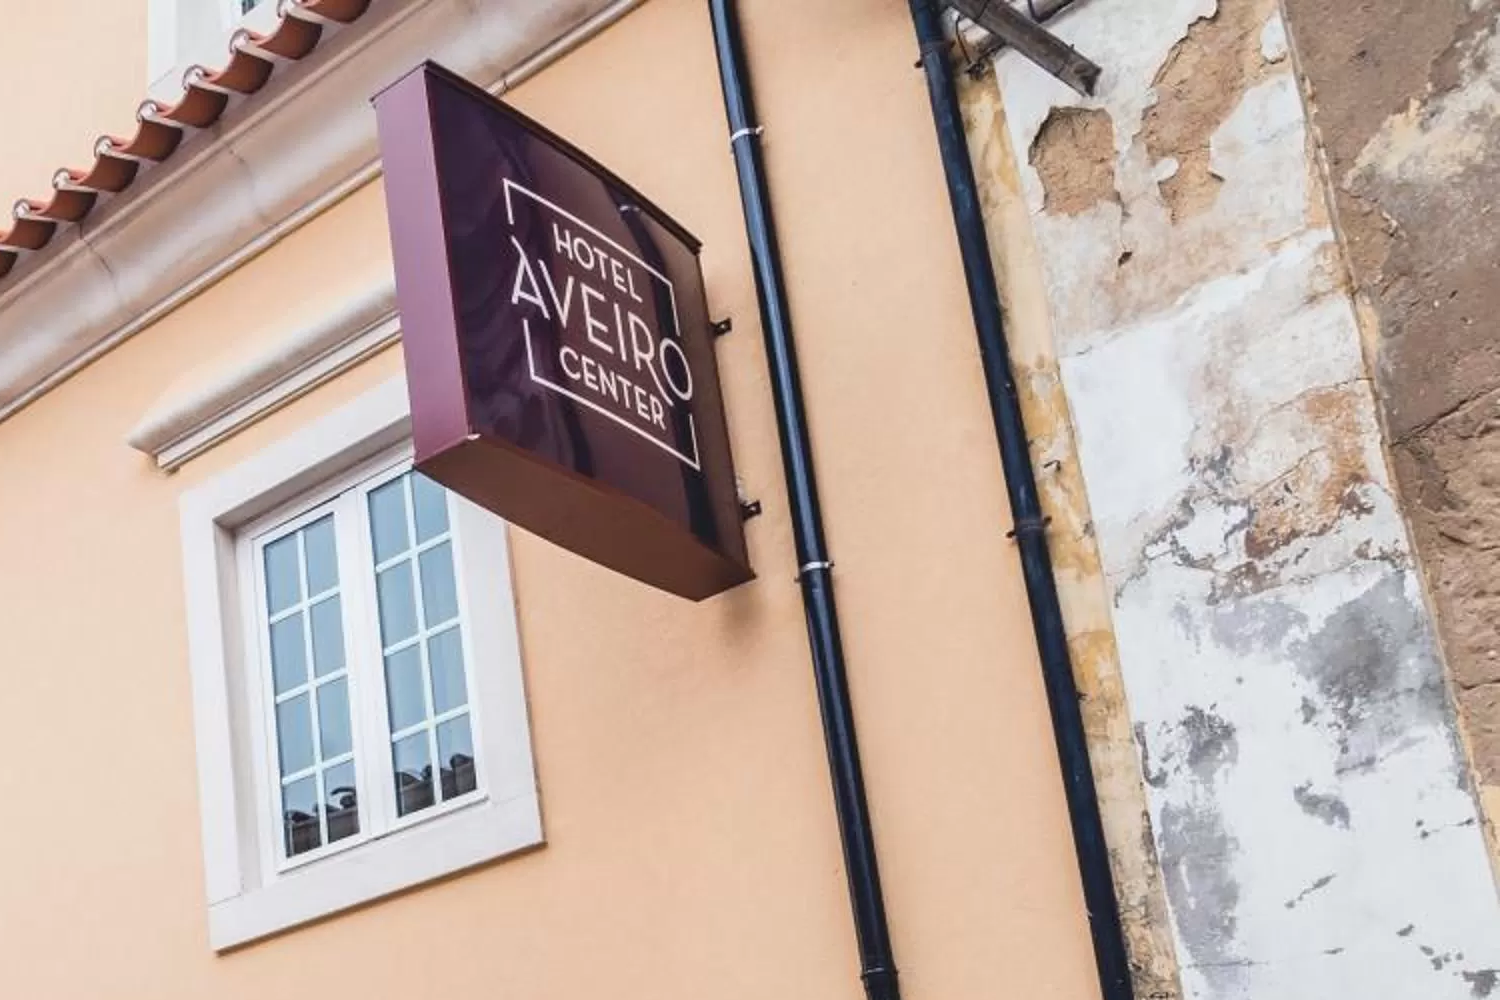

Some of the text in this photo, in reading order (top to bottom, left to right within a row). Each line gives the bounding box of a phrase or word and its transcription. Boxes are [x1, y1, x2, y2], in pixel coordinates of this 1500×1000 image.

[553, 223, 643, 303] HOTEL
[511, 236, 693, 406] AVEIRO
[559, 347, 667, 430] CENTER
